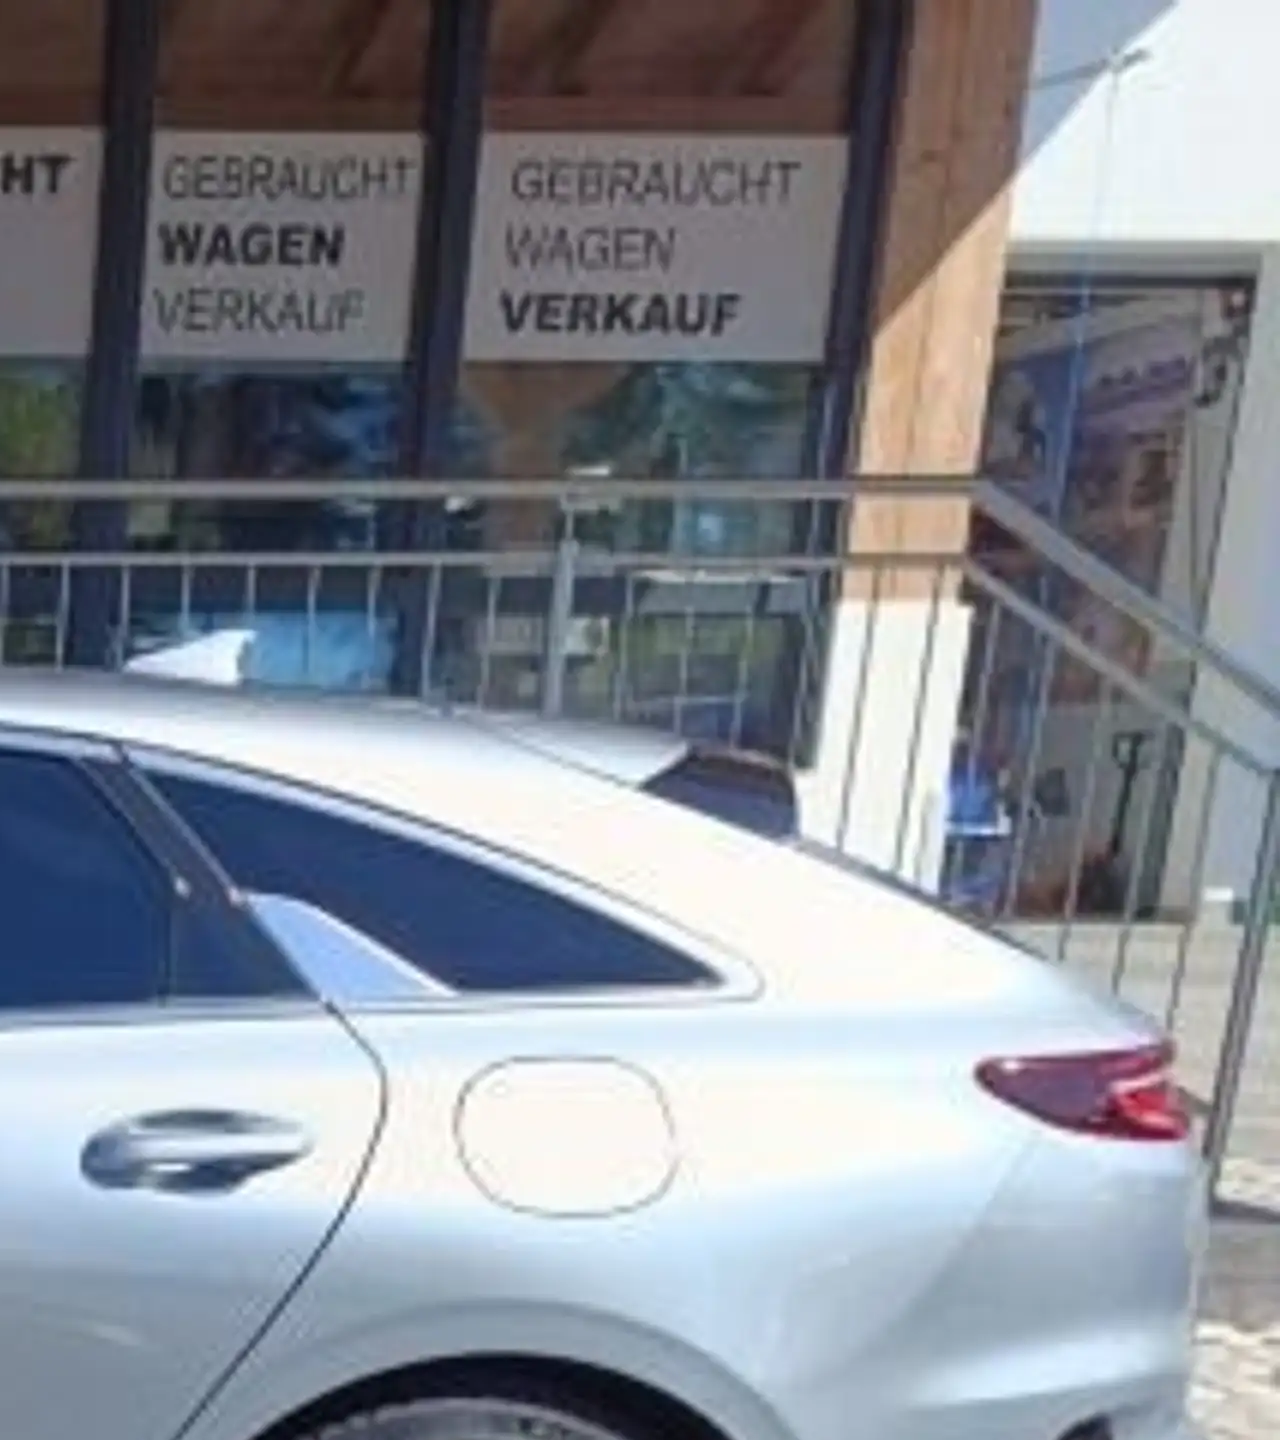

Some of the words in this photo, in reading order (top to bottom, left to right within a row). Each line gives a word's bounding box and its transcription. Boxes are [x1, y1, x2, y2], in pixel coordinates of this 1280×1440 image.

[162, 154, 416, 201] GEBRAUCHT
[511, 158, 801, 207] GEBRAUCHT
[158, 222, 345, 266] WAGEN
[505, 222, 675, 273] WAGEN
[152, 287, 364, 332] VERKAUF
[500, 290, 742, 336] VERKAUF
